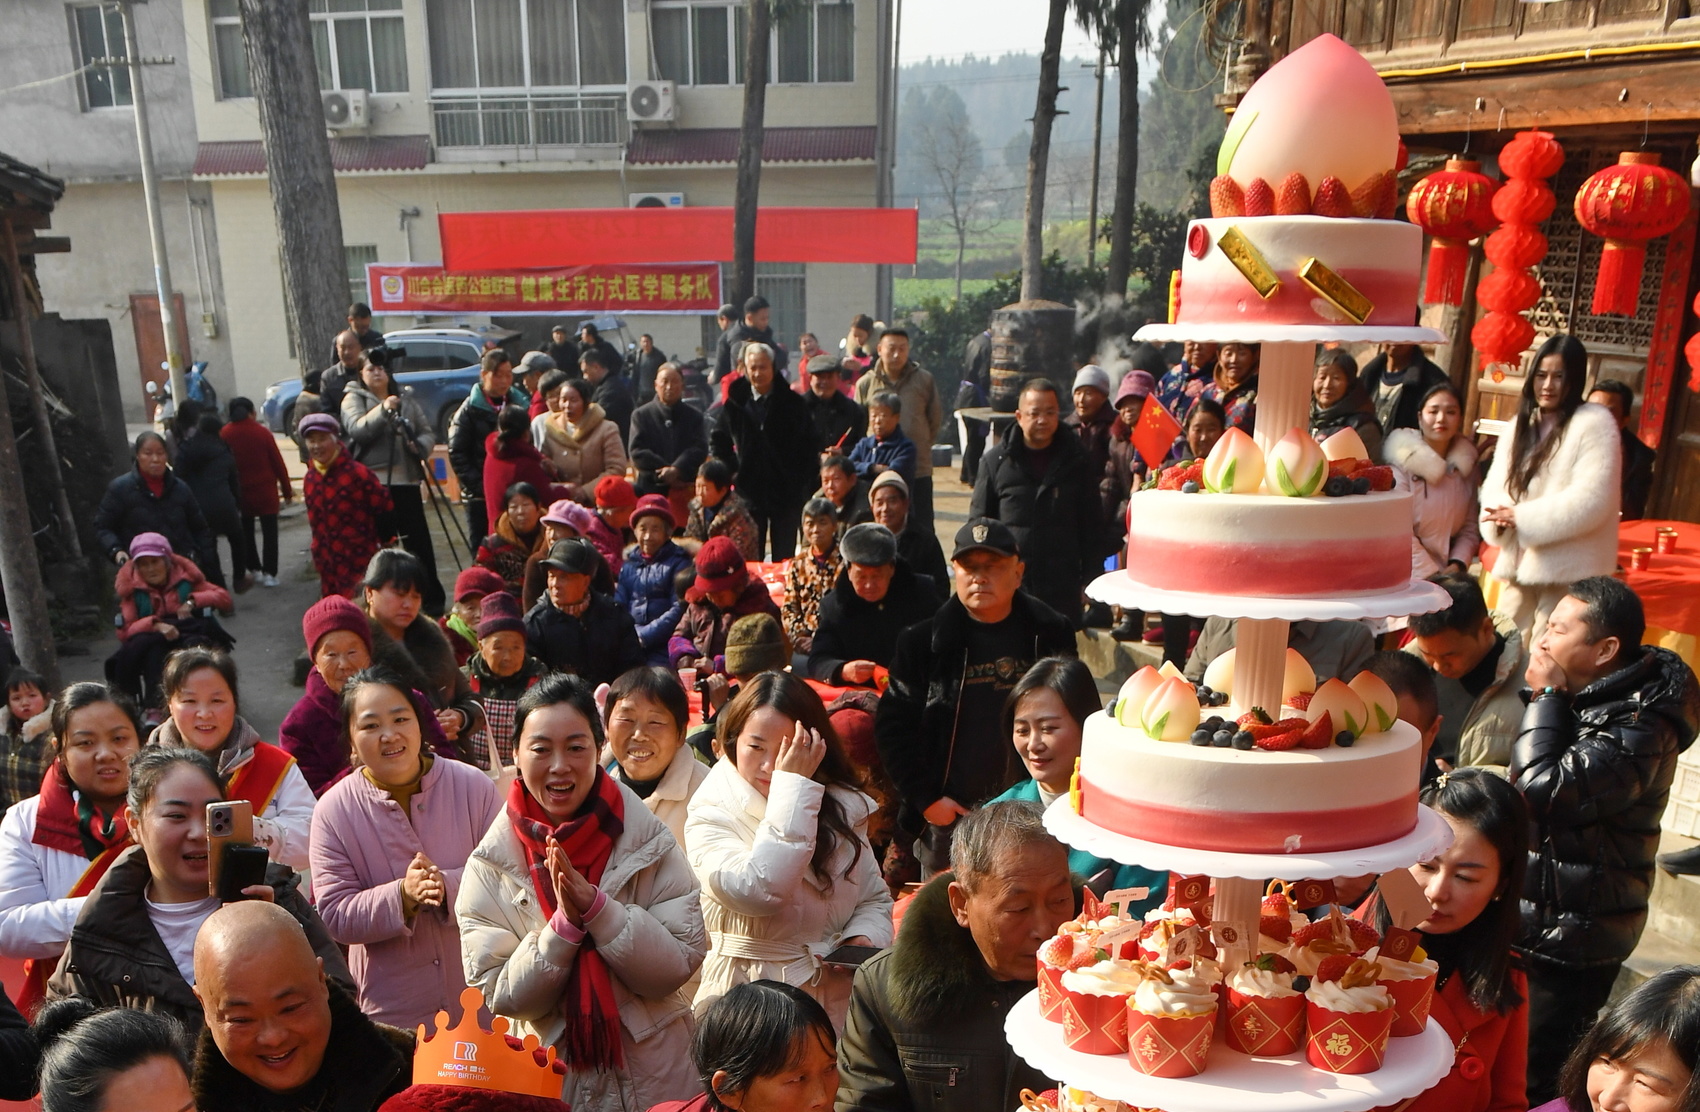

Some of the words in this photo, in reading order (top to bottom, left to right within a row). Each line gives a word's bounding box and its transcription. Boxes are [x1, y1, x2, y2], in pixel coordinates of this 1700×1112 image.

[521, 274, 713, 302] 健康生活方式医学服务队
[1241, 1014, 1263, 1040] 寿
[1139, 1034, 1160, 1061] 寿
[1325, 1032, 1352, 1056] 福
[458, 1072, 491, 1081] BIRTHDAY
